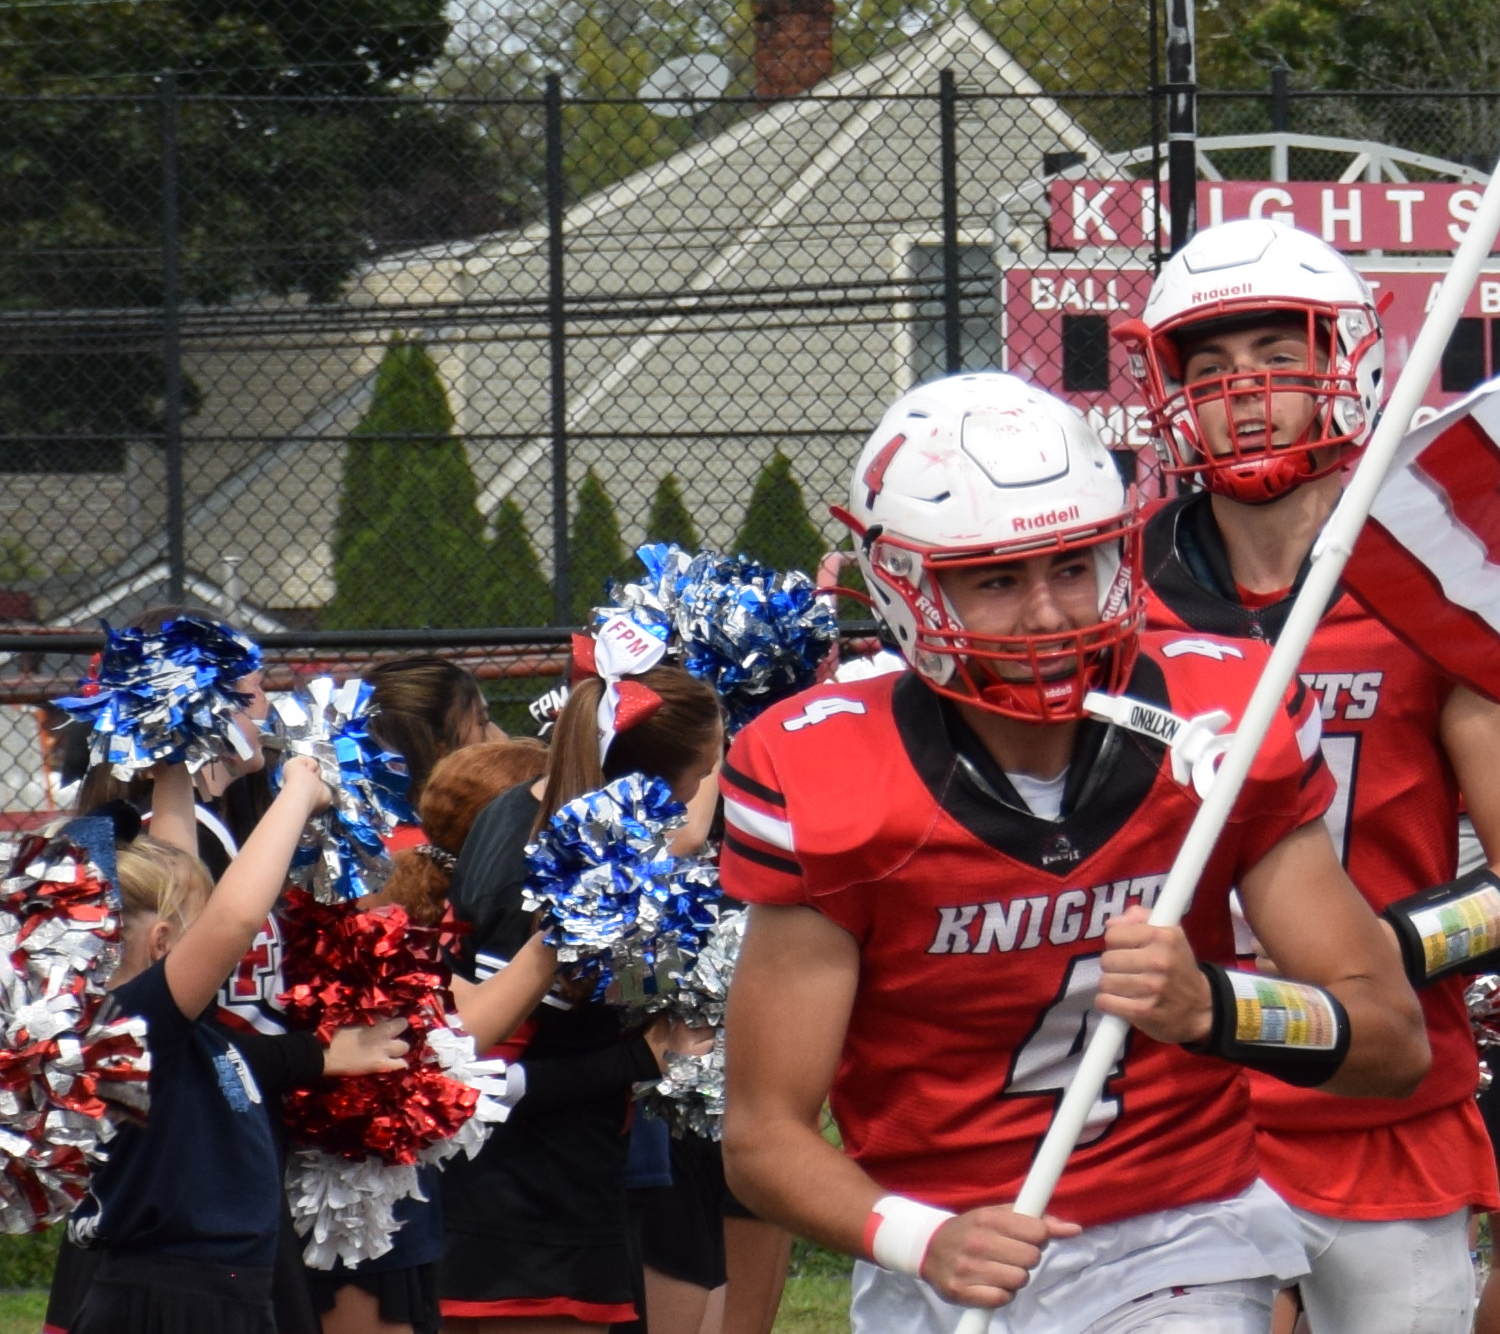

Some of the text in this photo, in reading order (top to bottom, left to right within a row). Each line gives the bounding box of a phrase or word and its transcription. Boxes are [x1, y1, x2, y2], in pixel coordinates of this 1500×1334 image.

[1030, 278, 1129, 310] BALL
[1011, 505, 1080, 533] Riddell
[1101, 566, 1132, 622] Riddell
[606, 620, 650, 658] FPM
[528, 685, 569, 720] FPM
[782, 697, 866, 732] 4
[1130, 705, 1181, 741] NXTRND
[927, 872, 1168, 955] KNIGHT
[1002, 953, 1126, 1151] 4
